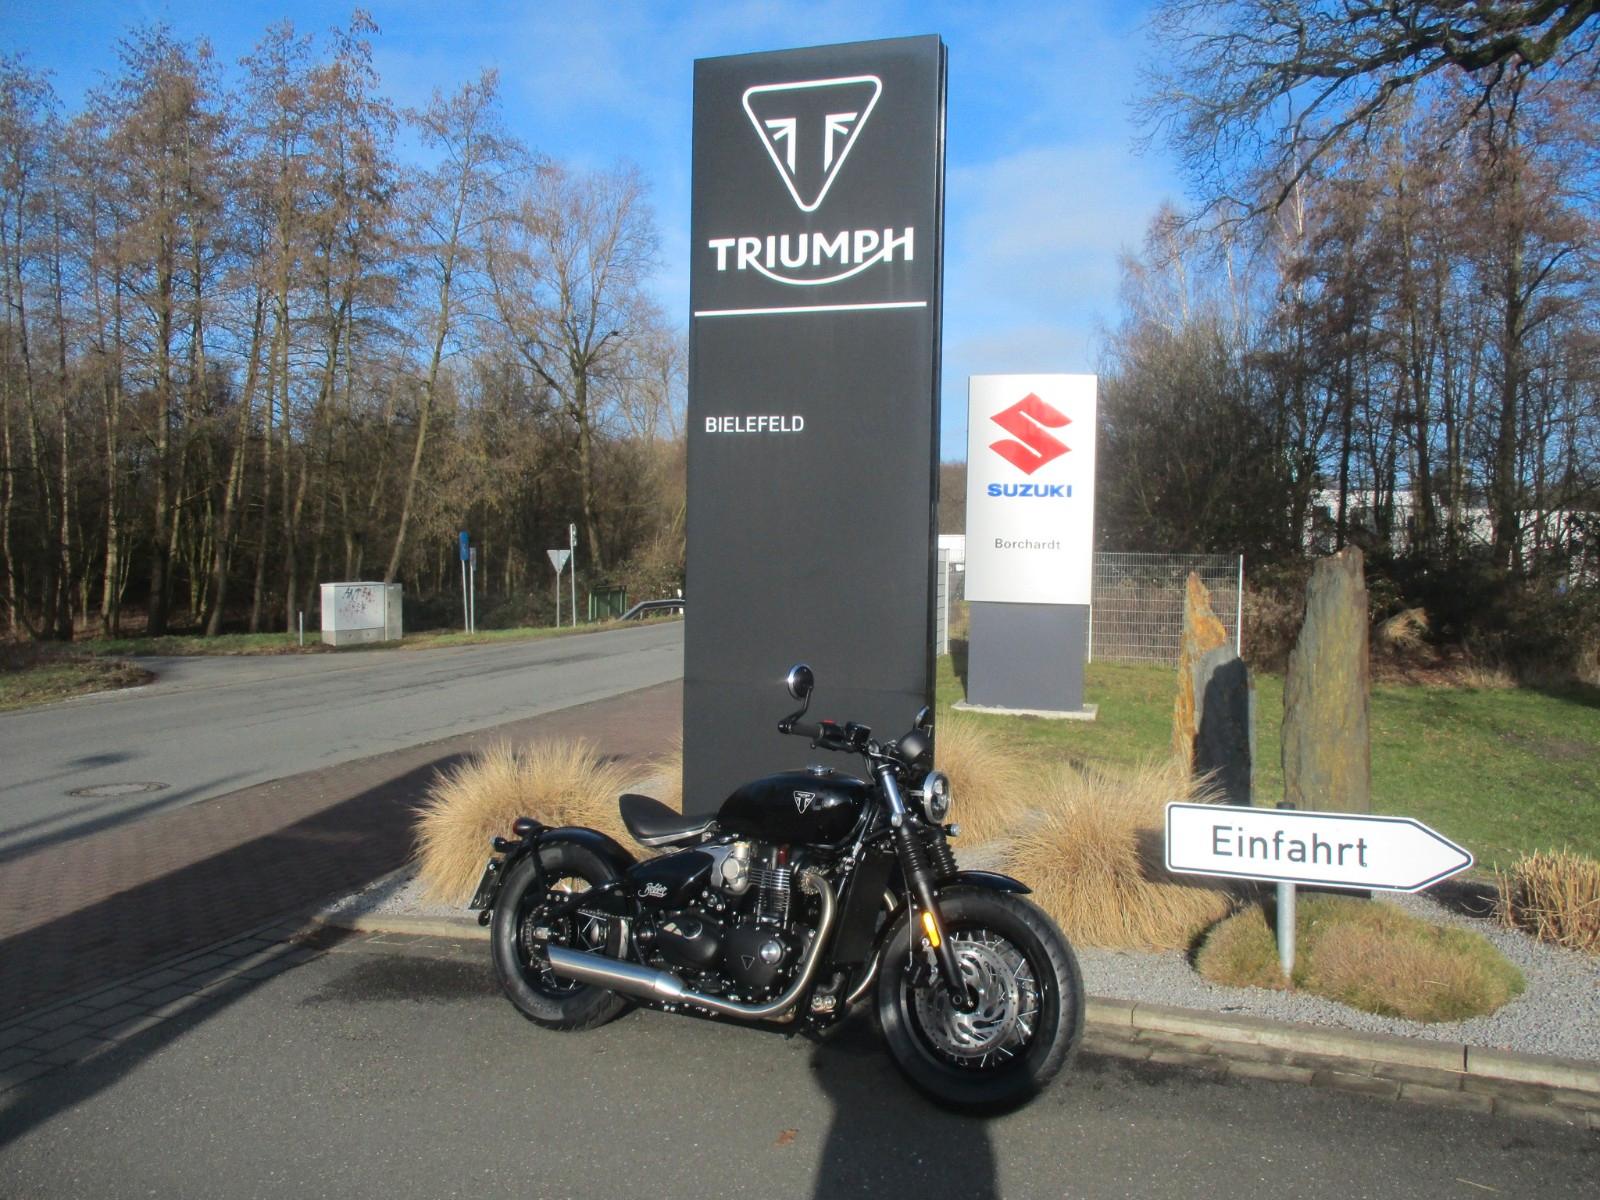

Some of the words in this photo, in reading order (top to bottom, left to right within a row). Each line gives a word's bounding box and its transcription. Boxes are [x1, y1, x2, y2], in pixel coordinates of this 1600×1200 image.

[708, 227, 915, 286] TRIUMPH
[704, 415, 805, 434] BIELEFELD
[987, 482, 1072, 498] SUZUKI
[994, 538, 1061, 551] Borchardt
[1212, 824, 1368, 867] Einfahrt
